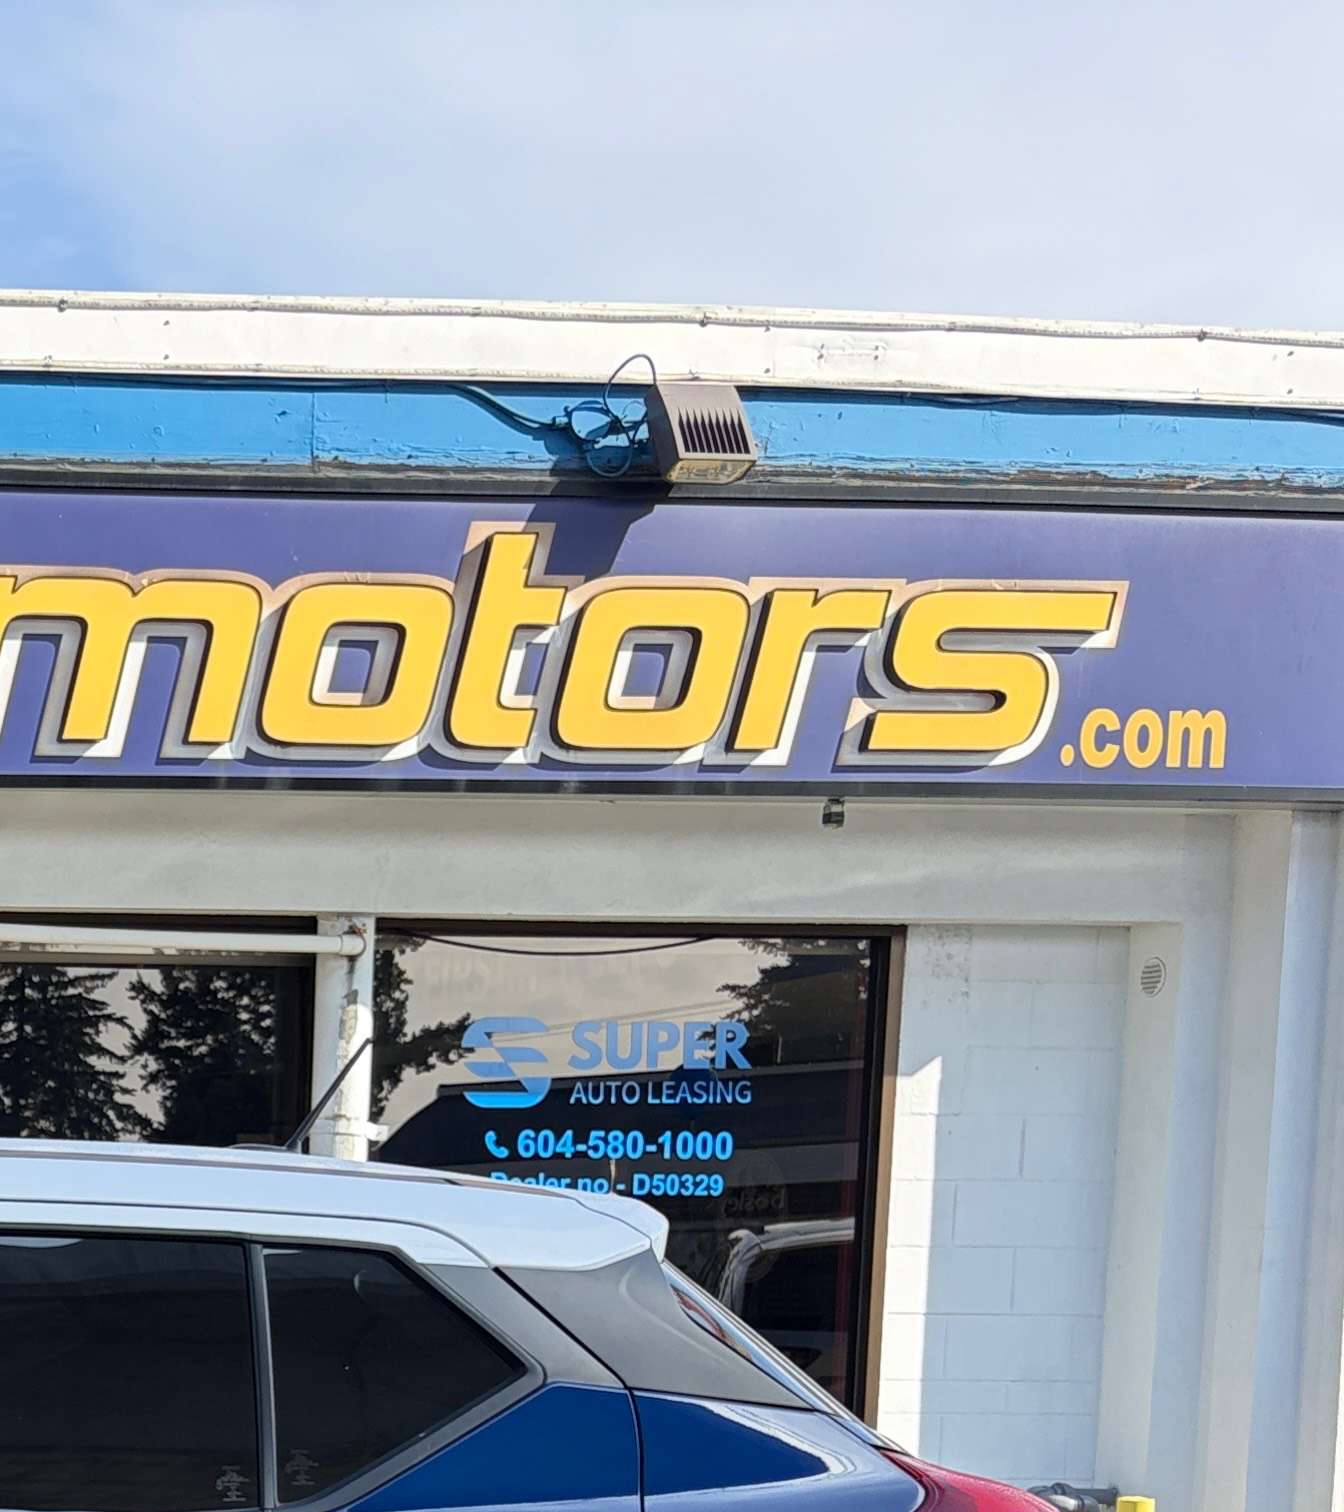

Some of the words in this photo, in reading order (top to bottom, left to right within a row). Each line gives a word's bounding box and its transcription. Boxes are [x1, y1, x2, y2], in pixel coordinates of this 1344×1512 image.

[1060, 707, 1227, 769] .com
[568, 1019, 753, 1071] SUPER
[569, 1080, 641, 1105] AUTO
[647, 1080, 753, 1105] LEASING
[517, 1129, 734, 1160] 604-580-1000
[577, 1178, 609, 1194] no
[633, 1173, 724, 1196] D50329
